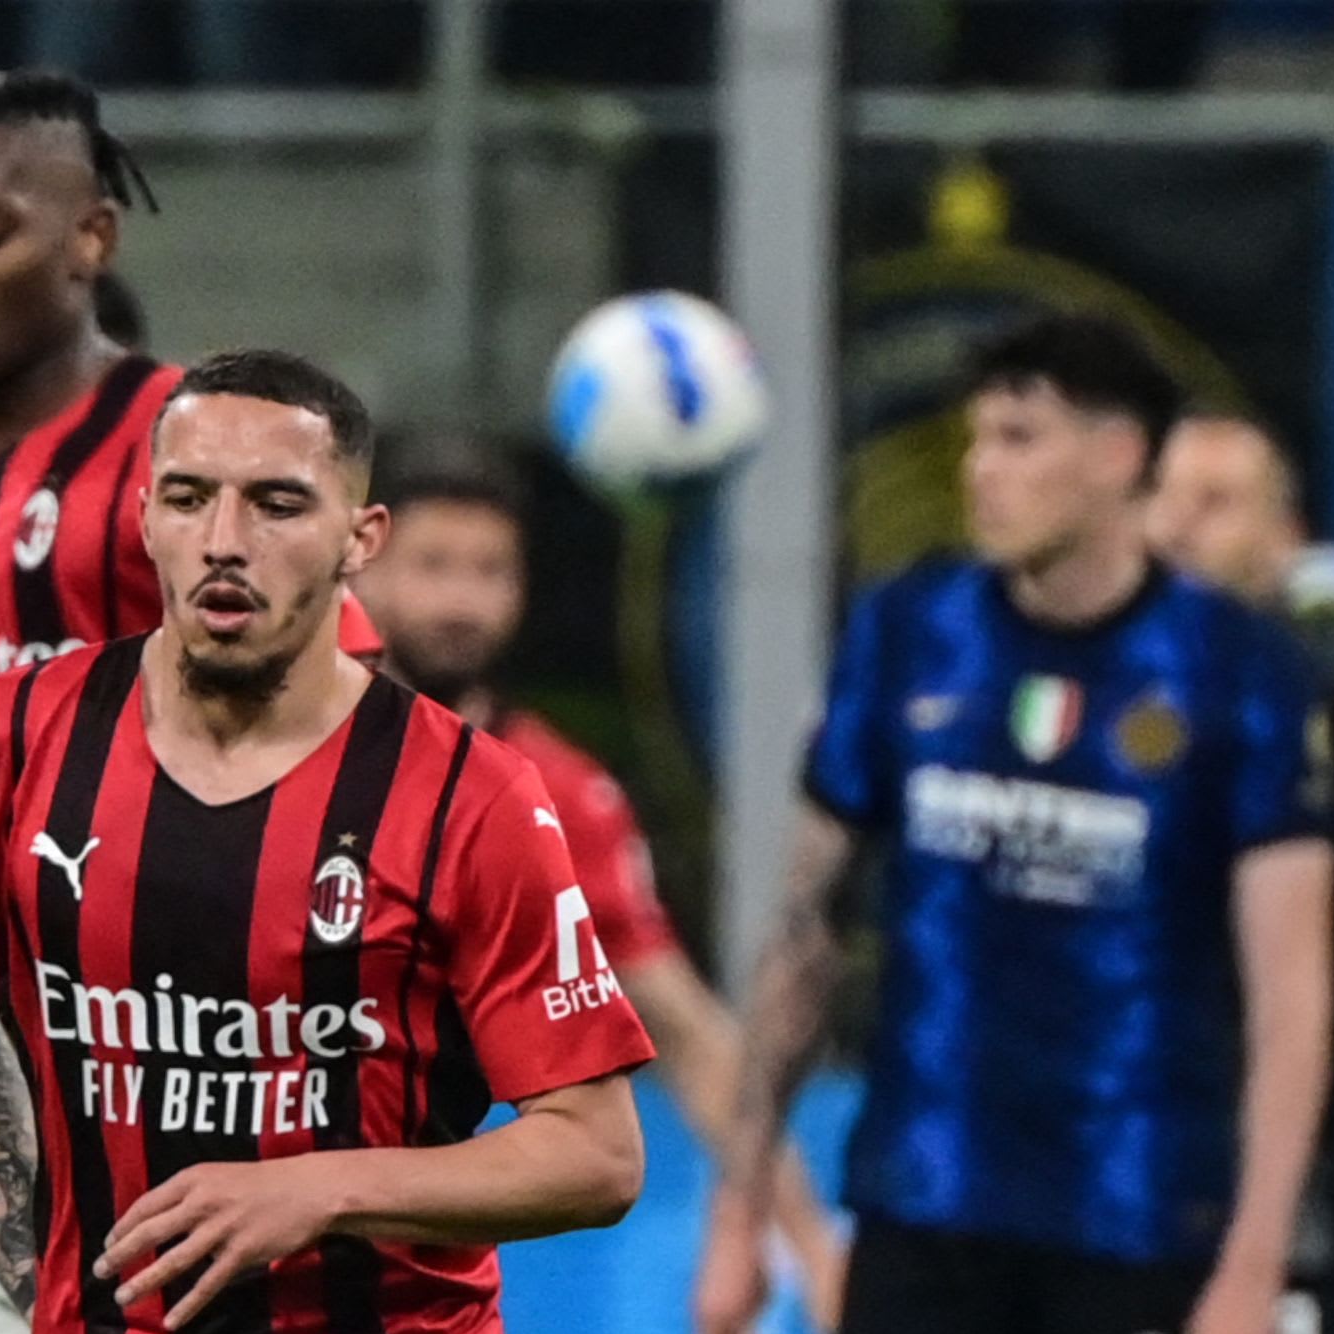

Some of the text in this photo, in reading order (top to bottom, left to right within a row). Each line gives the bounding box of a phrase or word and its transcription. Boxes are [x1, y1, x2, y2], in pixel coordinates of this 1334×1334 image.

[35, 958, 387, 1058] Emirates
[81, 1058, 330, 1136] FLY BETTER
